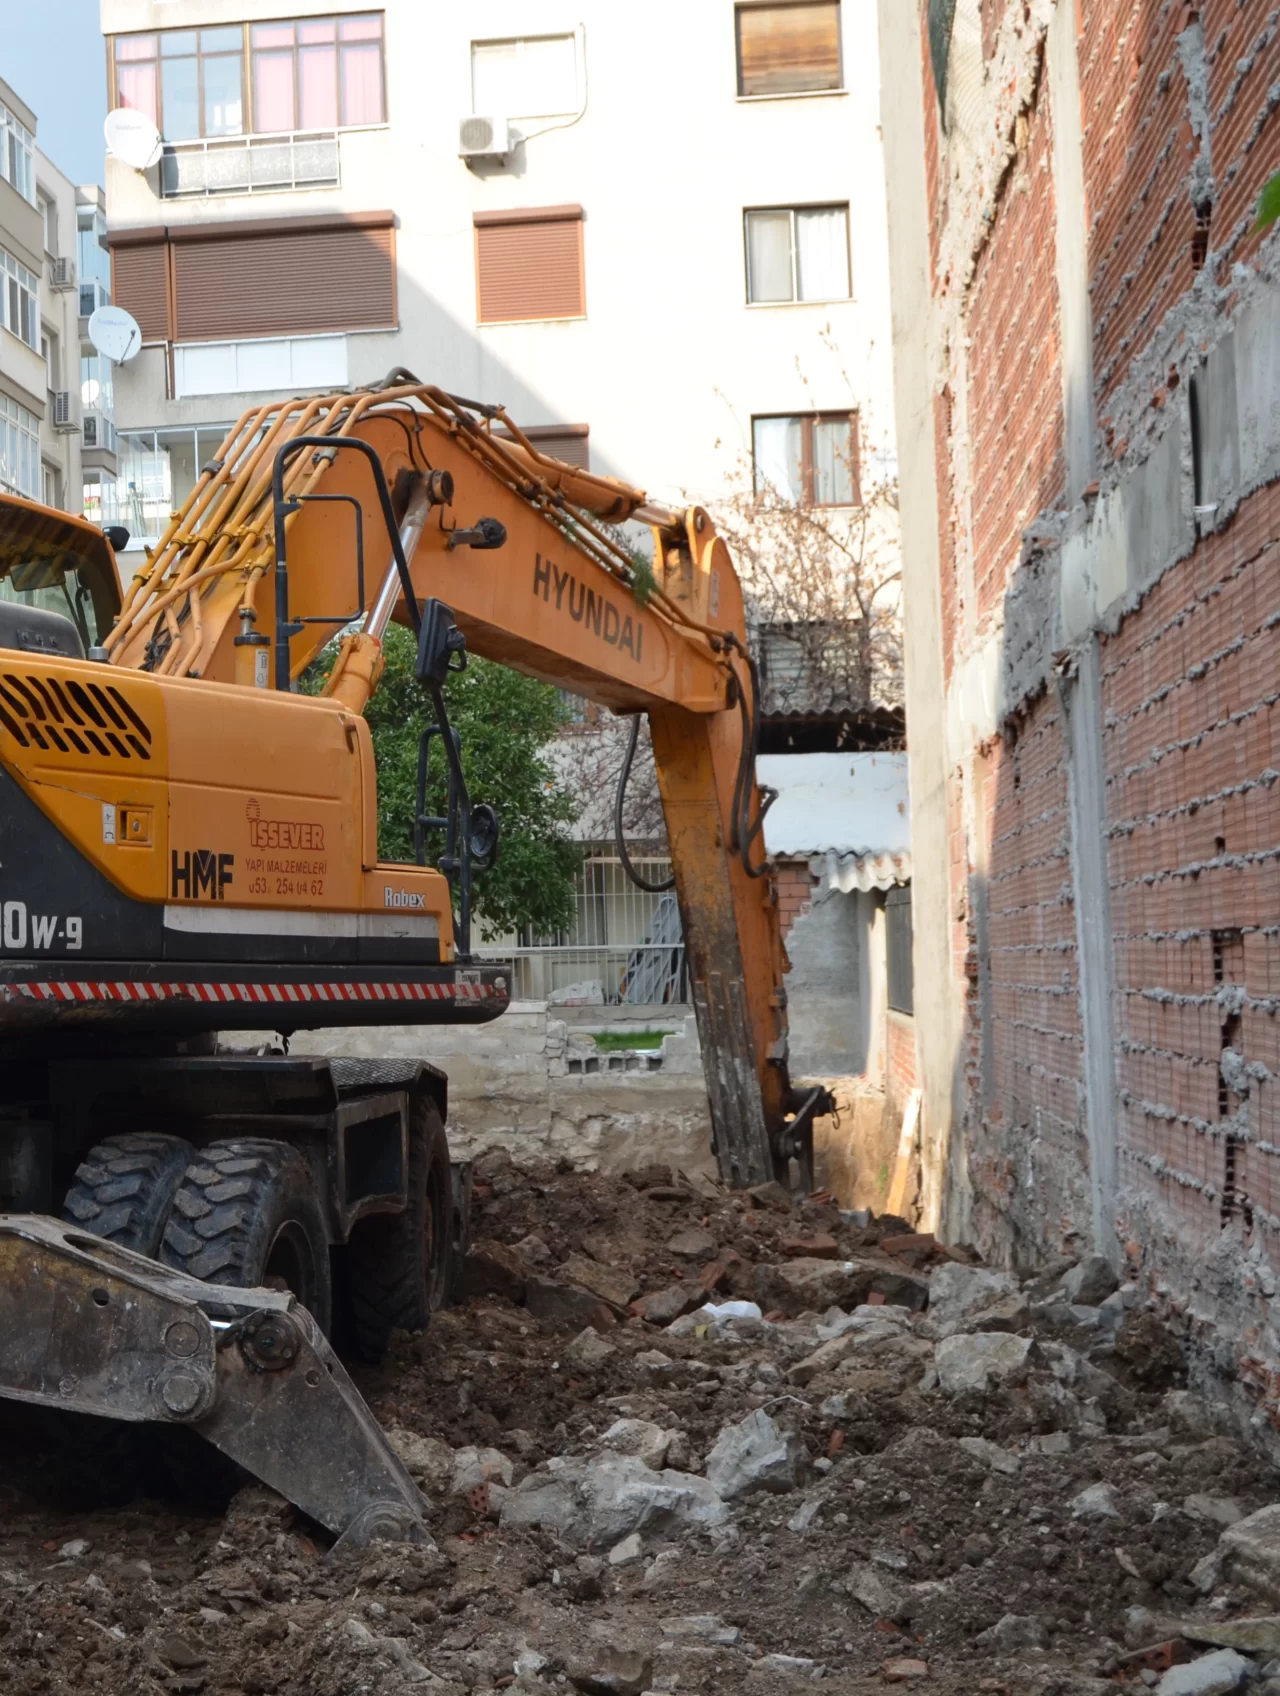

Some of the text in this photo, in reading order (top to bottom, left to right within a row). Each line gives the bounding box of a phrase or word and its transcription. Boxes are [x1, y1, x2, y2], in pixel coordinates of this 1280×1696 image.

[533, 552, 643, 663] HYUNDAI
[171, 849, 234, 900] HMF
[245, 859, 327, 875] YAPI MALZEMELERİ
[310, 880, 324, 896] 62
[384, 886, 426, 908] Robex
